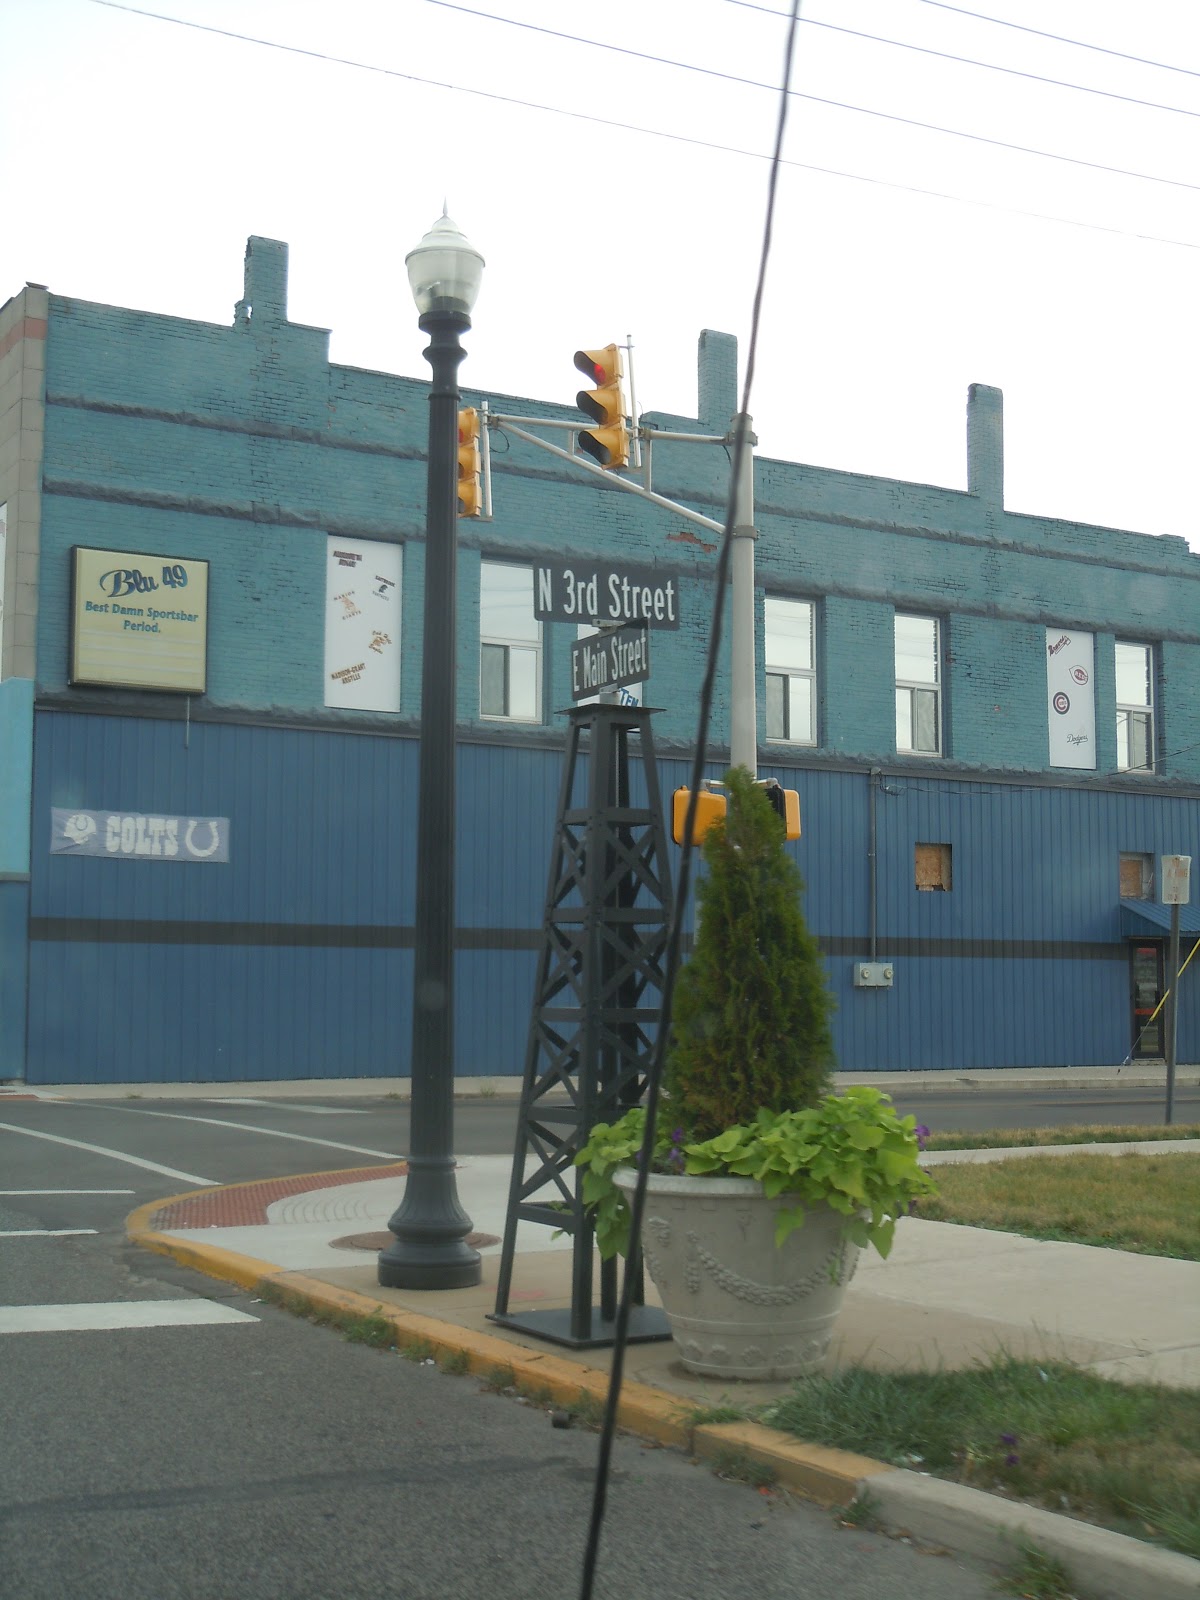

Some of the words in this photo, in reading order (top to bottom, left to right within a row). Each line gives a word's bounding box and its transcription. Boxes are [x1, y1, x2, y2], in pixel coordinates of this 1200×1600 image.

[99, 569, 159, 597] Blu
[162, 564, 188, 588] 49
[538, 568, 552, 611] N
[563, 569, 598, 615] 3rd
[608, 573, 675, 621] Street
[85, 600, 109, 612] Best
[112, 603, 144, 616] Damn
[146, 607, 199, 622] Sportsbar
[123, 620, 161, 633] Period.
[573, 650, 580, 692] E
[583, 643, 607, 689] Main
[611, 628, 647, 681] Street
[106, 815, 178, 856] COLTS
